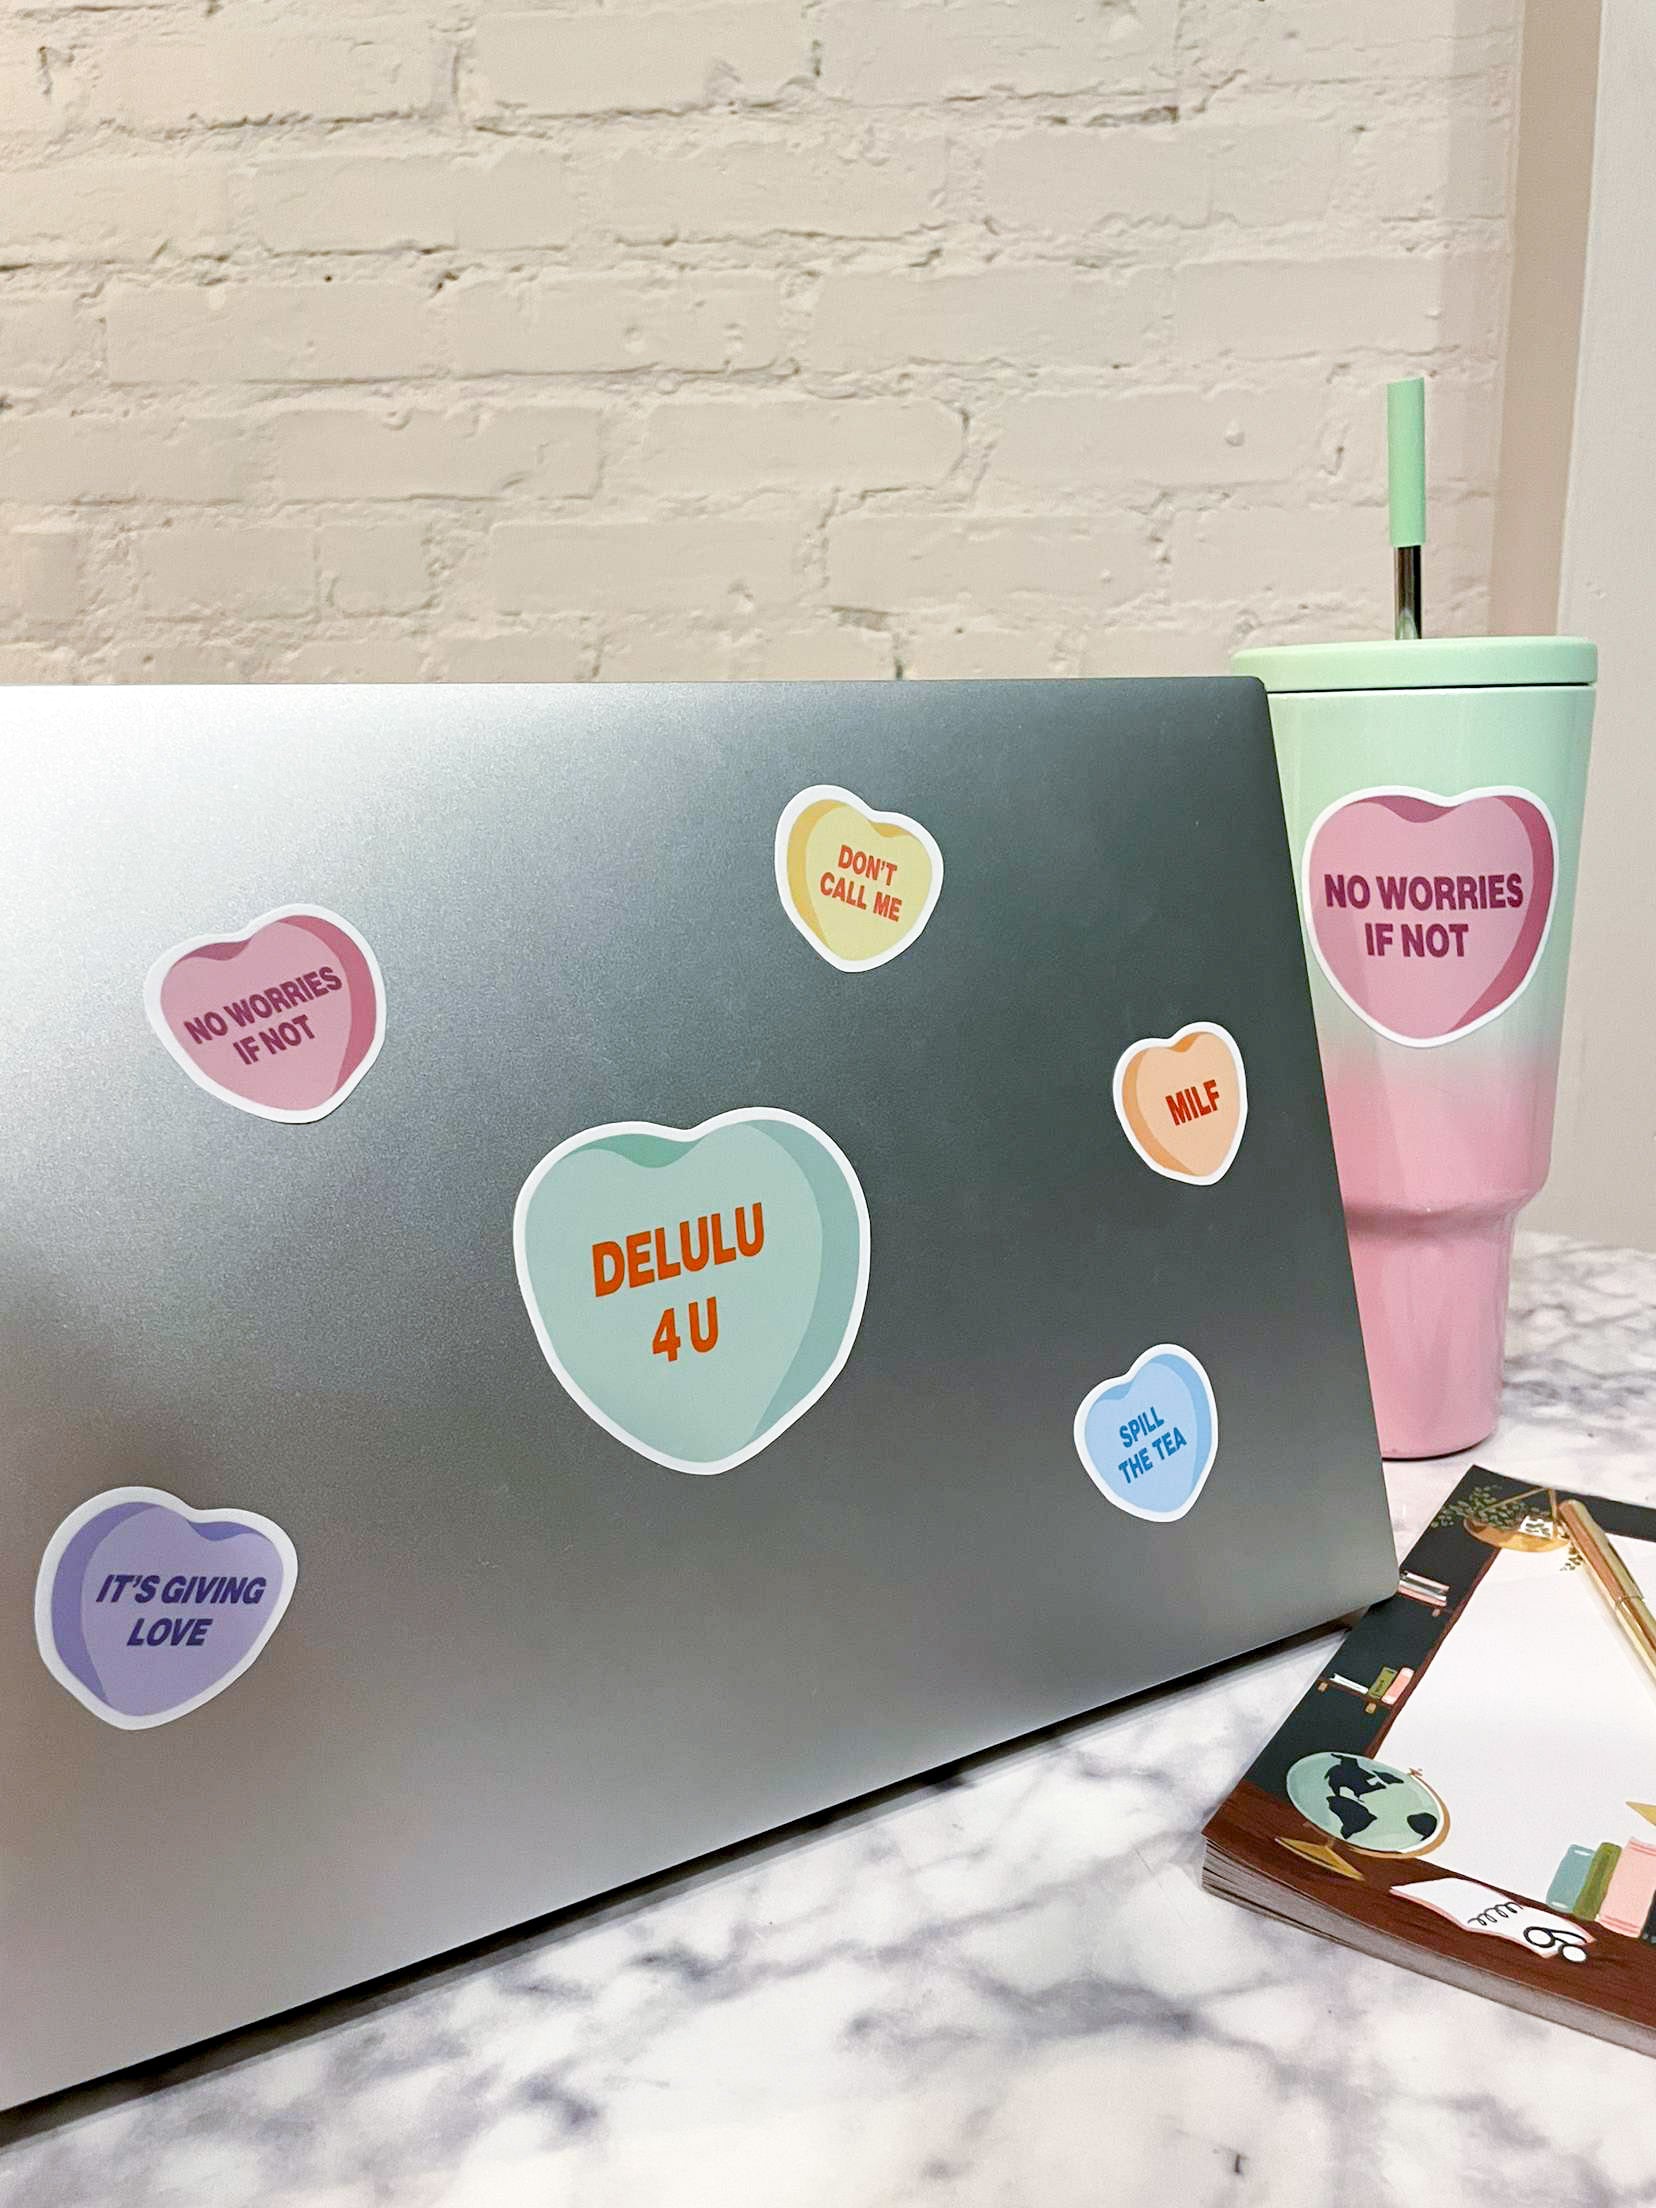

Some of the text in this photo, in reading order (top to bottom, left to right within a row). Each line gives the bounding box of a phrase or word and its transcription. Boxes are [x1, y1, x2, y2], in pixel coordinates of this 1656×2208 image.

[838, 844, 898, 886] DON'T
[820, 871, 903, 922] CALL ME
[1324, 873, 1524, 911] NO WORRIES
[1364, 923, 1469, 958] IF NOT
[183, 966, 343, 1045] NO WORRIES
[232, 1014, 316, 1065] IF NOT
[1165, 1079, 1220, 1126] MILF
[591, 1202, 765, 1298] DELULU
[652, 1296, 719, 1363] 4 U
[1119, 1406, 1165, 1448] SPILL
[1118, 1426, 1188, 1484] THE TEA
[95, 1574, 267, 1605] IT'S GIVING
[126, 1617, 214, 1647] LOVE
